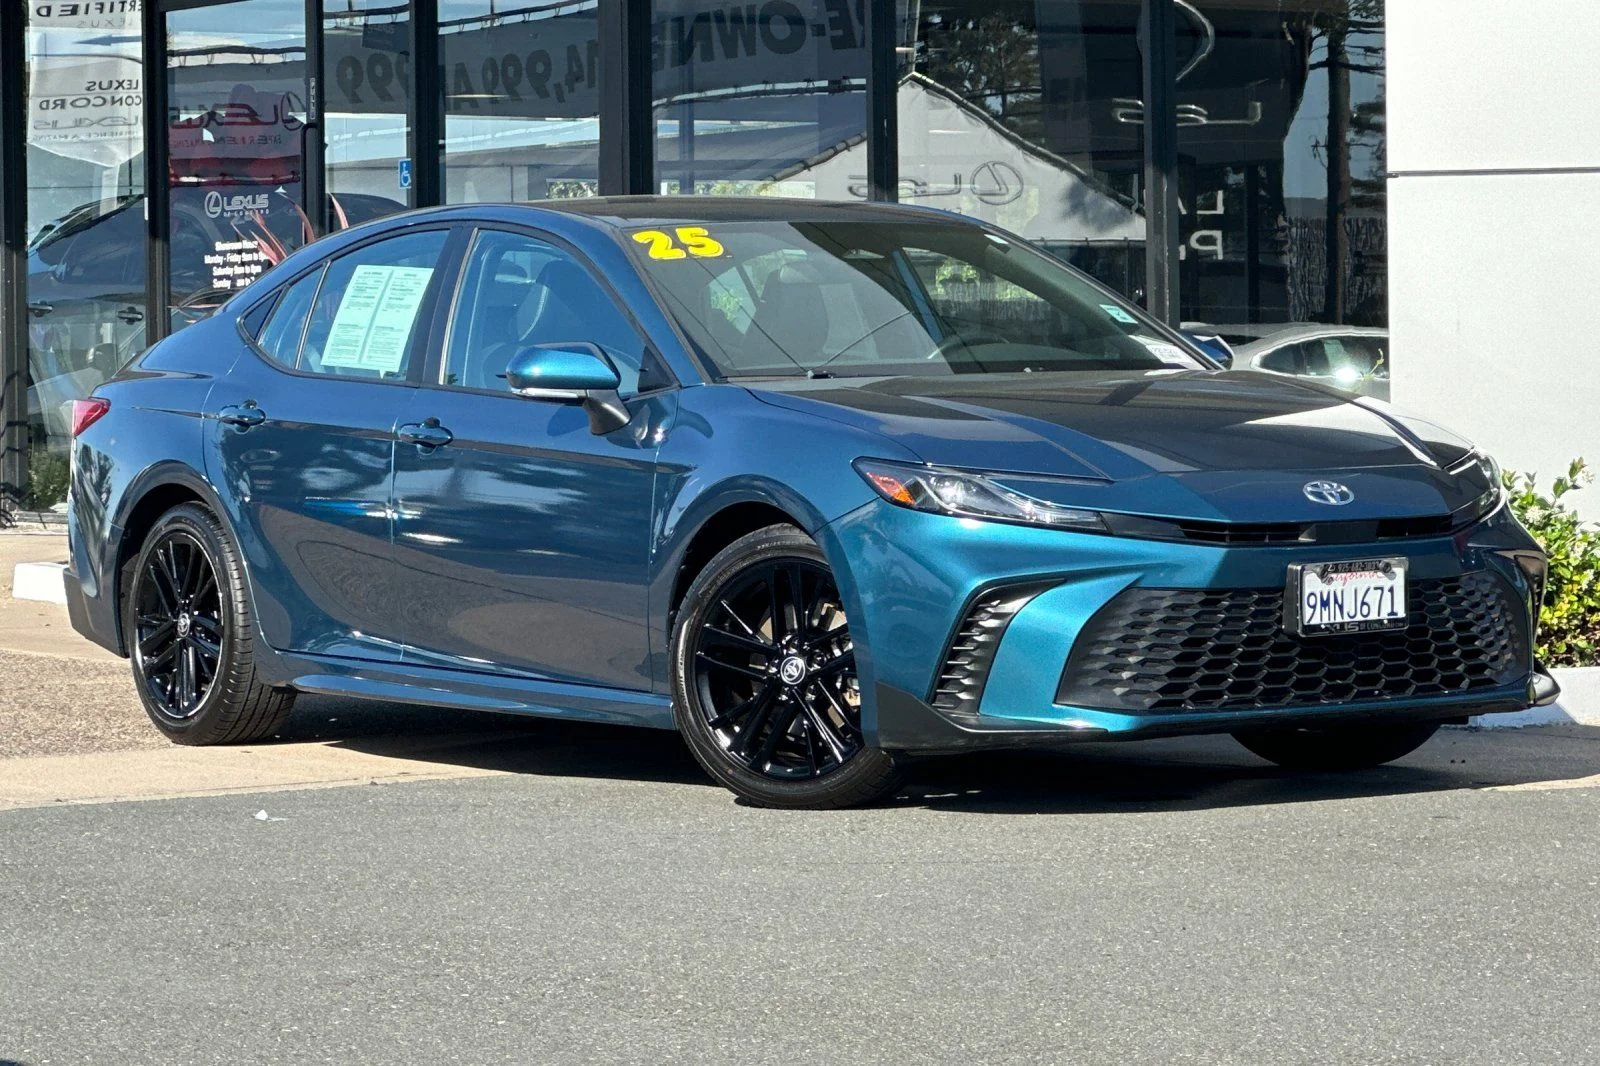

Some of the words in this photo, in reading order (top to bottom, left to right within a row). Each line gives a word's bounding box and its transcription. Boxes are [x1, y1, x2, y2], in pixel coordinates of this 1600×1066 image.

[223, 194, 269, 210] LEXUS
[632, 226, 724, 260] 25
[1306, 585, 1398, 623] 9MNJ671
